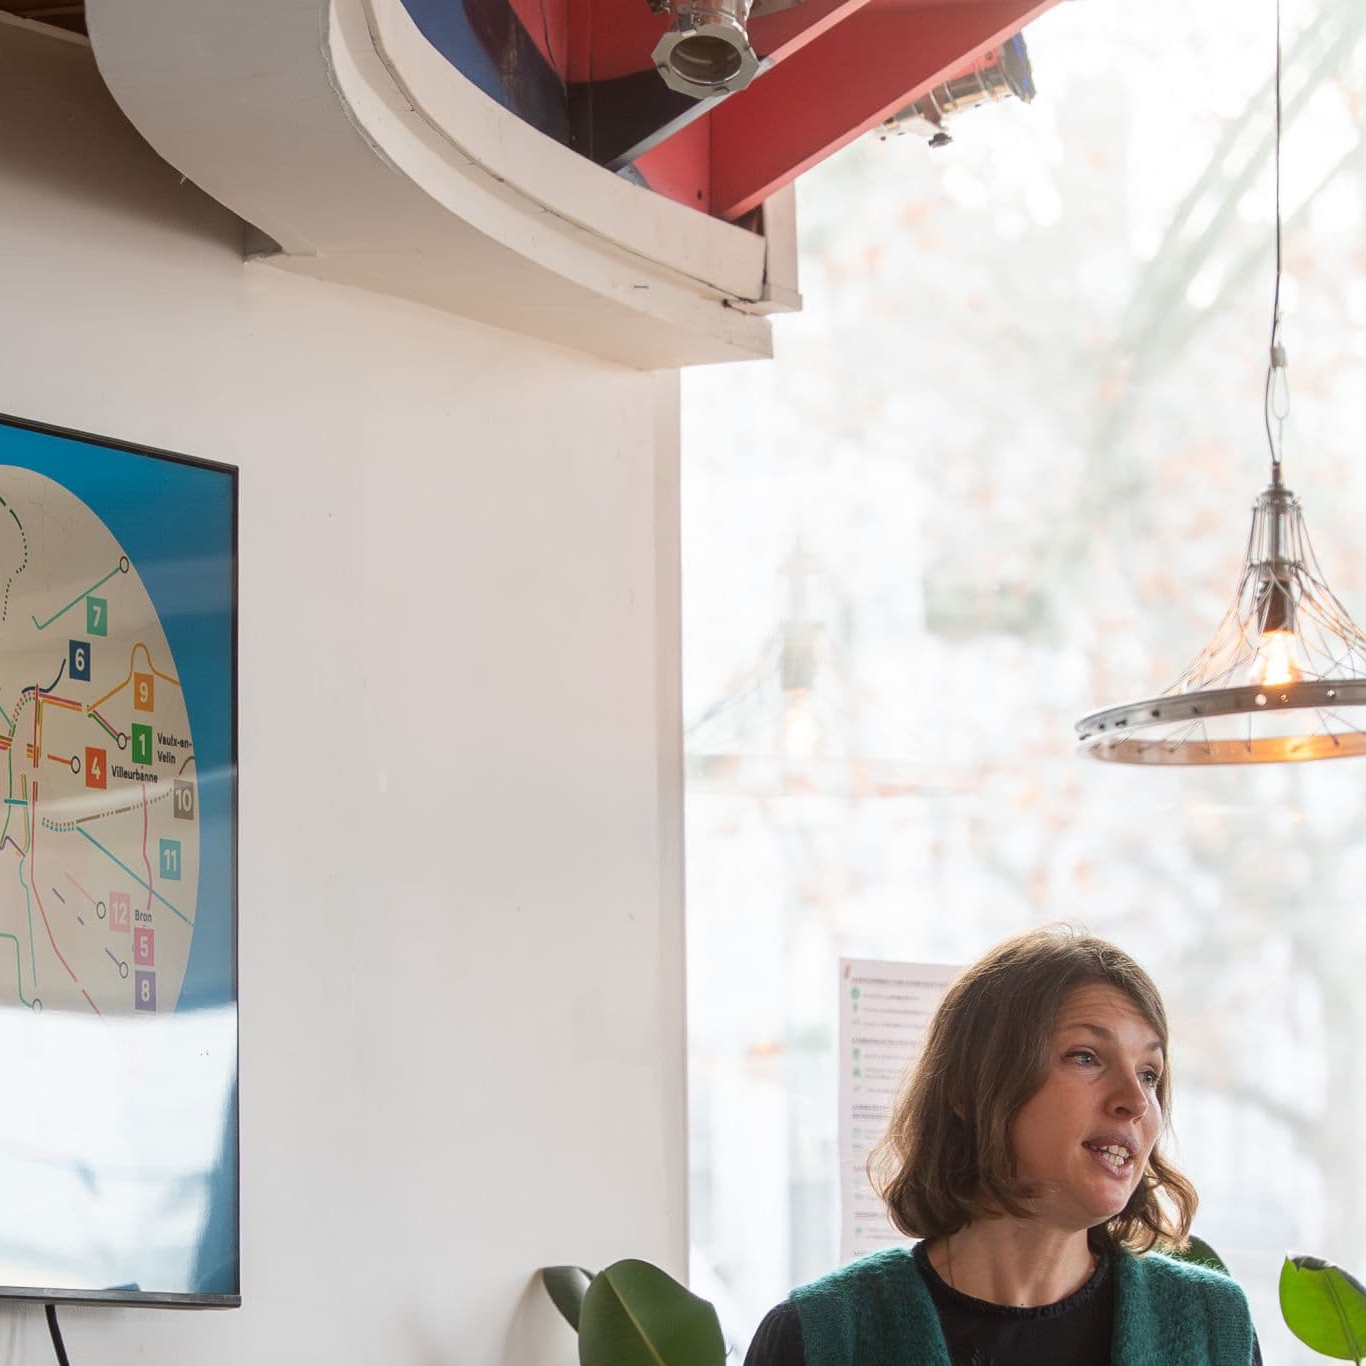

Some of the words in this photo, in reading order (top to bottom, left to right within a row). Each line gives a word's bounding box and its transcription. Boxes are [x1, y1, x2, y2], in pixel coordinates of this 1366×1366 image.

[91, 605, 103, 628] 7
[74, 648, 86, 672] 6
[138, 680, 149, 704] 9
[137, 733, 146, 756] 1
[157, 732, 192, 751] Vaulx-en-
[157, 750, 176, 765] Velin
[90, 759, 101, 781] 4
[111, 765, 159, 784] Villeurbanne
[175, 788, 193, 813] 10
[163, 848, 178, 873] 11
[112, 900, 128, 926] 12
[134, 909, 152, 923] Bron
[139, 935, 150, 959] 5
[140, 978, 151, 1002] 8
